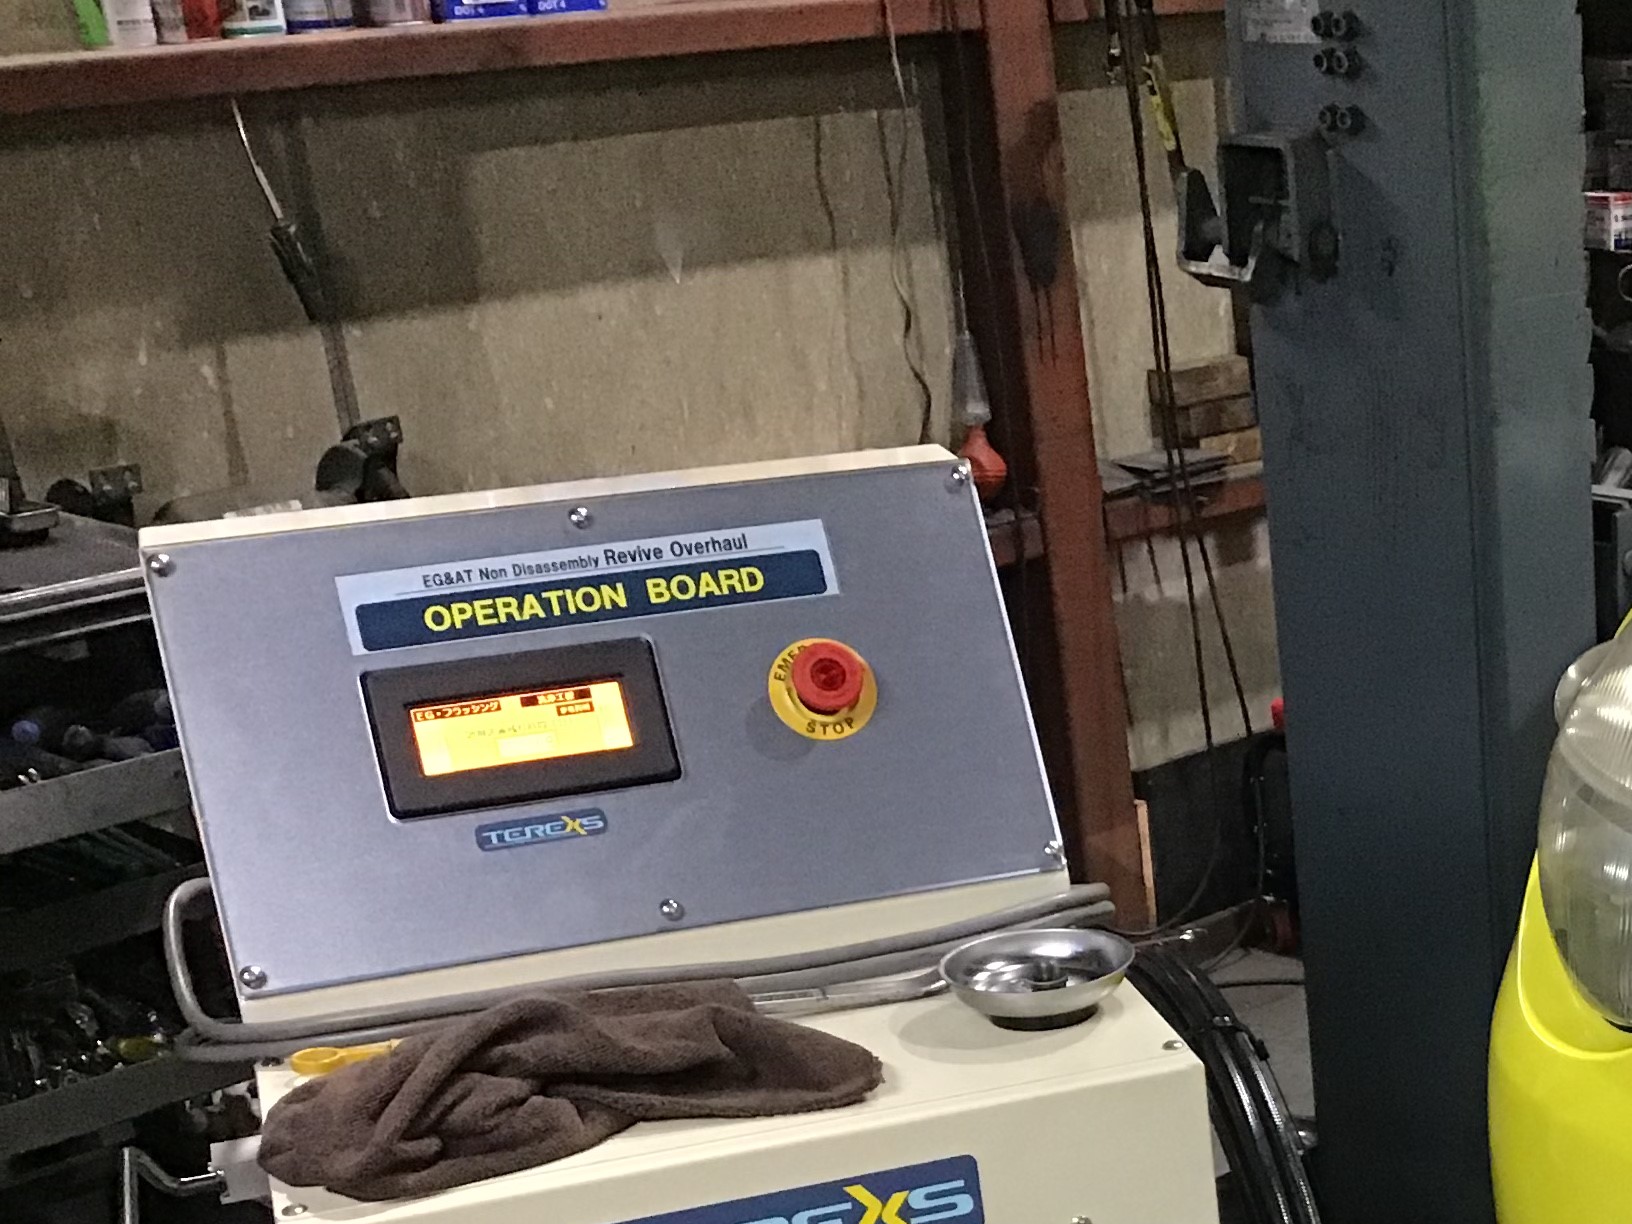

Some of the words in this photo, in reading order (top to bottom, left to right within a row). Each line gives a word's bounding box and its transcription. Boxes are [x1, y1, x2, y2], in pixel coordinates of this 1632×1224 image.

[422, 569, 473, 589] EG&AT
[479, 565, 508, 580] Non
[513, 555, 600, 579] Disassembly
[603, 546, 664, 567] Revive
[670, 533, 749, 558] Overhaul
[424, 583, 627, 631] OPERATION
[648, 566, 764, 604] BOARD
[806, 717, 855, 736] STOP
[482, 815, 605, 844] TEREXS
